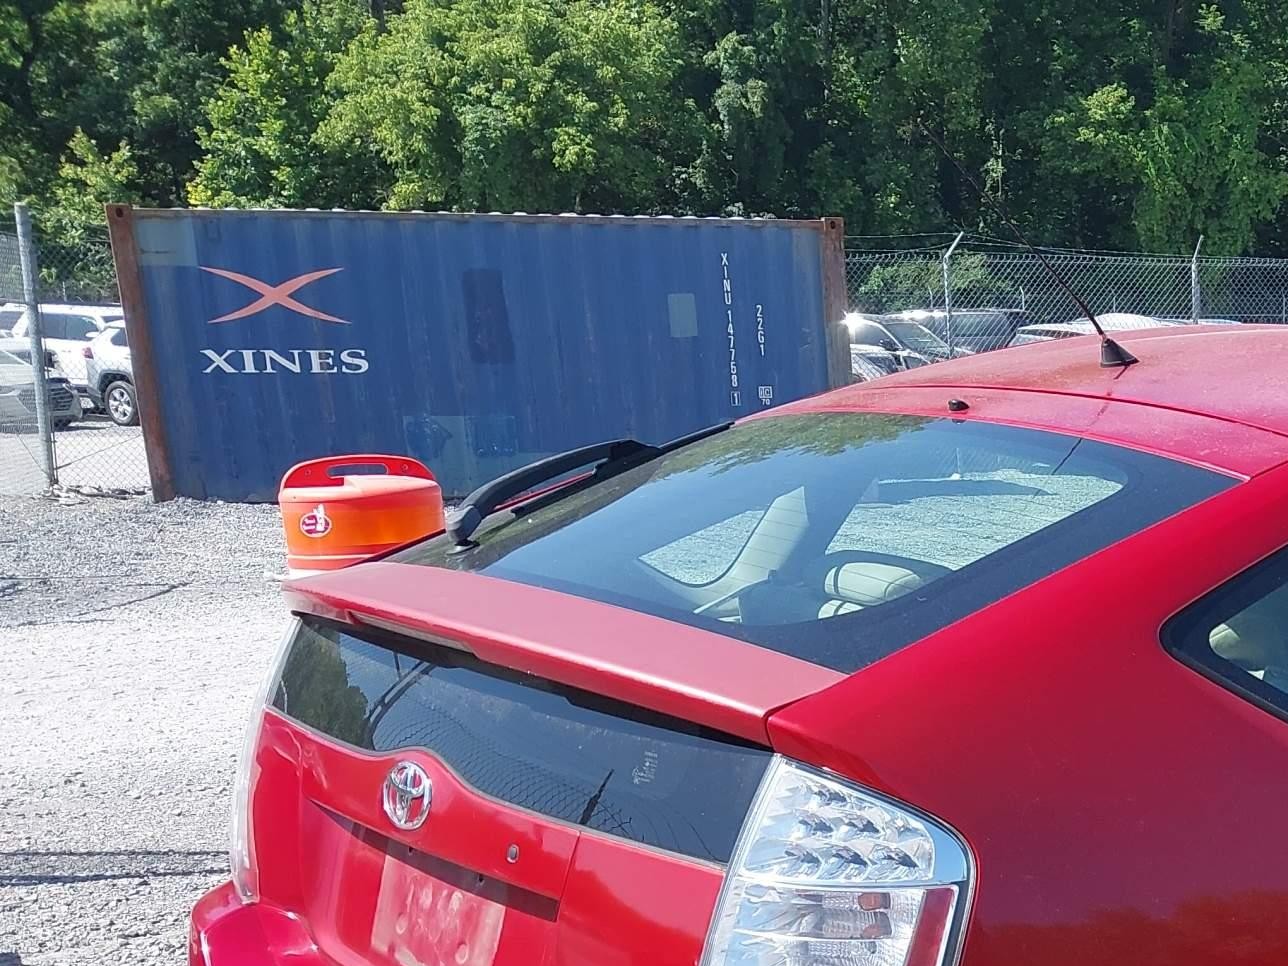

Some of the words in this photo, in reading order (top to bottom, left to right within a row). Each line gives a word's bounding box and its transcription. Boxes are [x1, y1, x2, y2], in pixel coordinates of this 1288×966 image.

[720, 252, 732, 305] XINU
[756, 304, 766, 357] 22G1
[199, 349, 369, 374] XINES
